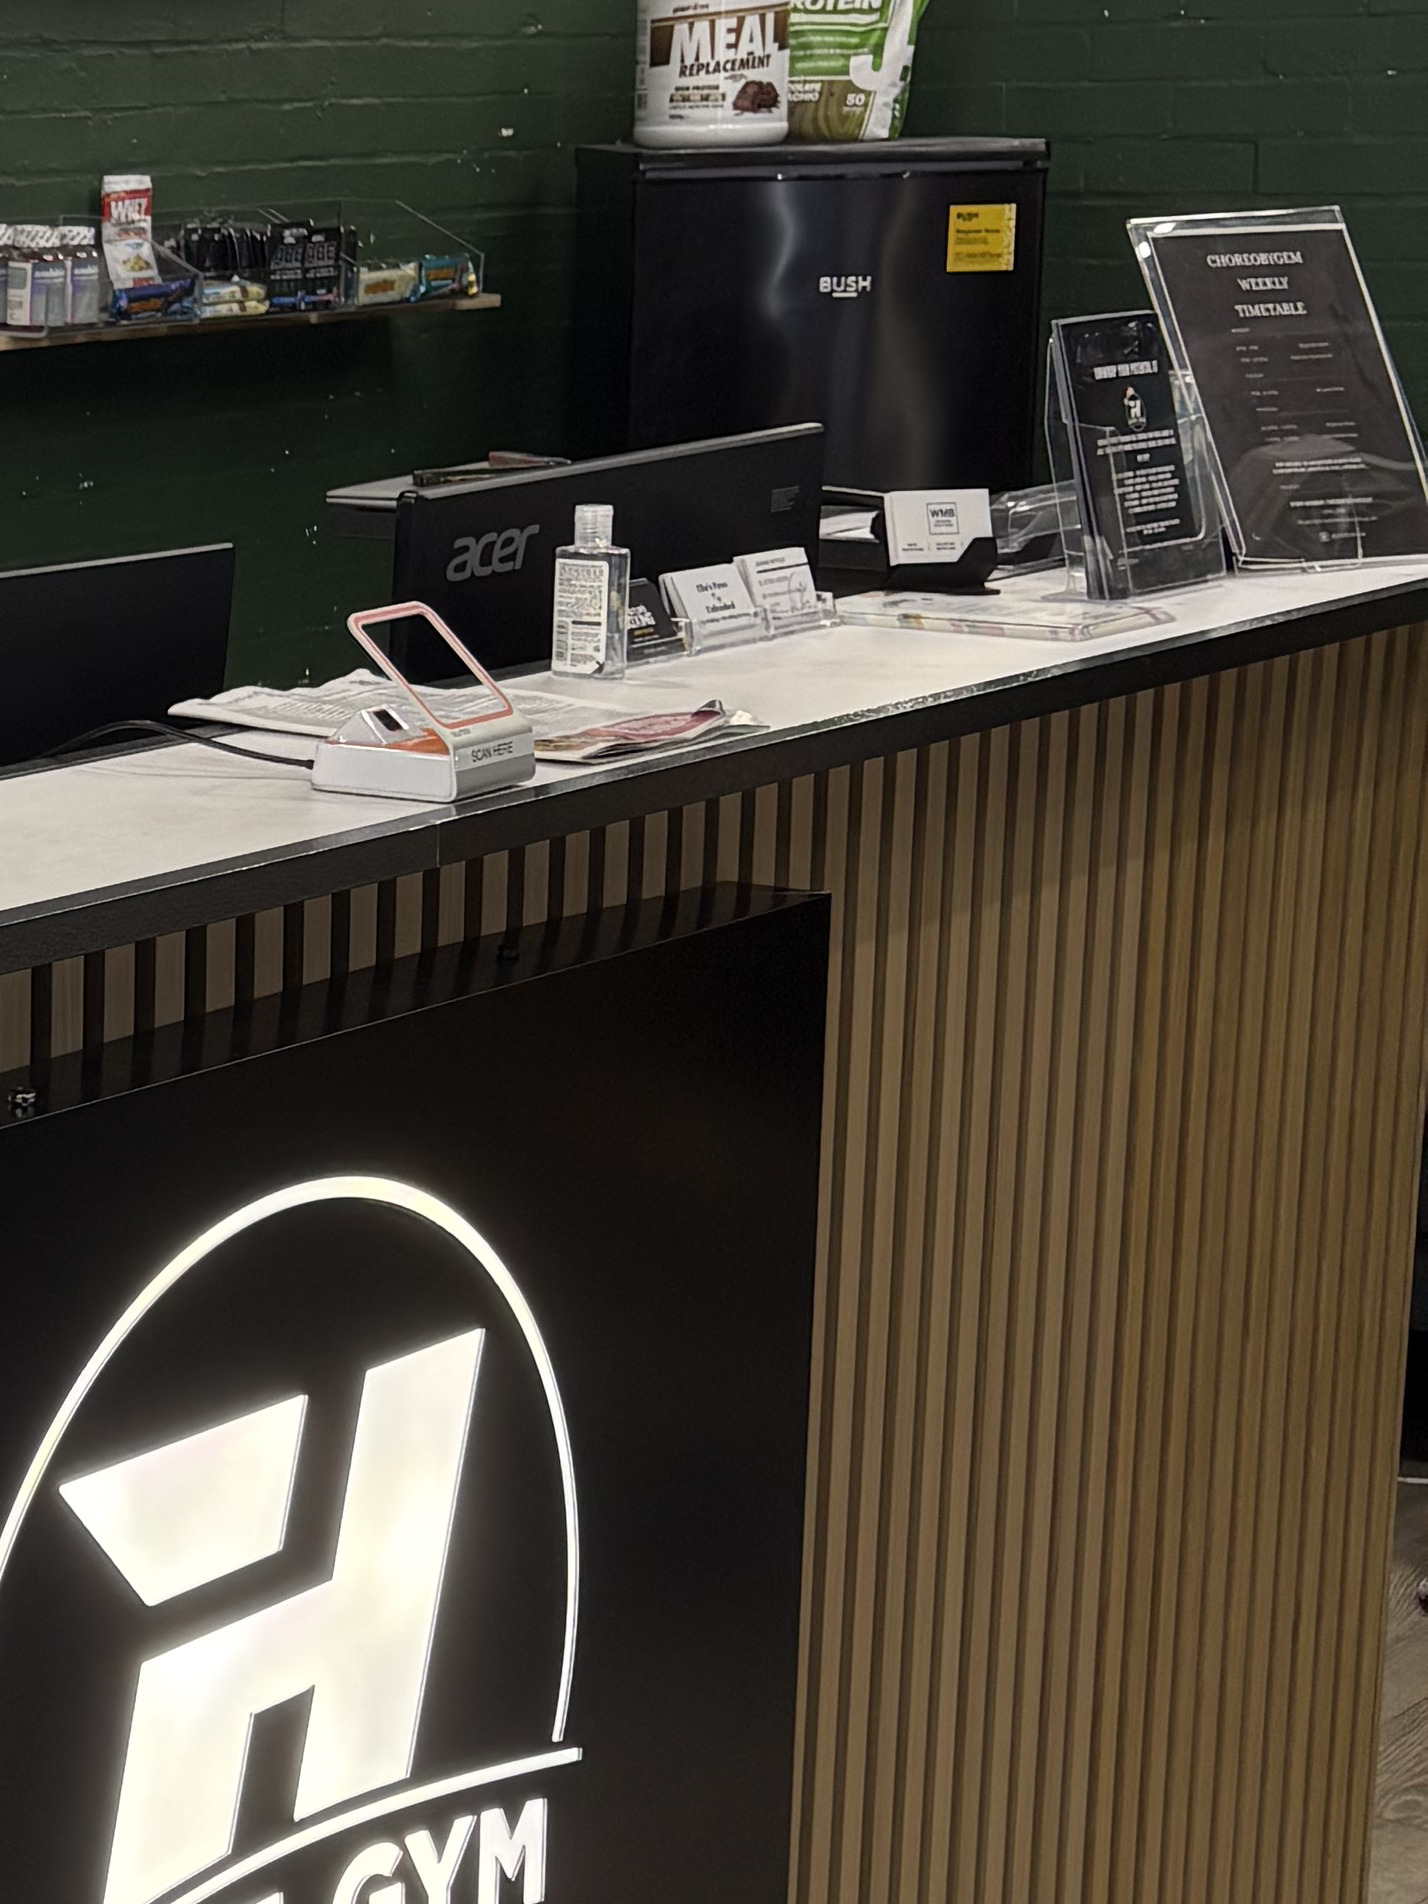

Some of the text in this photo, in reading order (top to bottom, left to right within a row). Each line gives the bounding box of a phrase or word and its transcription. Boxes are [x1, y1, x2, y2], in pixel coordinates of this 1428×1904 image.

[670, 11, 779, 65] MEAL
[679, 52, 772, 79] REPLACEMENT
[819, 276, 872, 293] BUSH
[1237, 277, 1289, 291] WEEKLY
[1234, 302, 1308, 318] TIMETABLE
[446, 524, 540, 582] acer
[471, 748, 492, 762] SCAN
